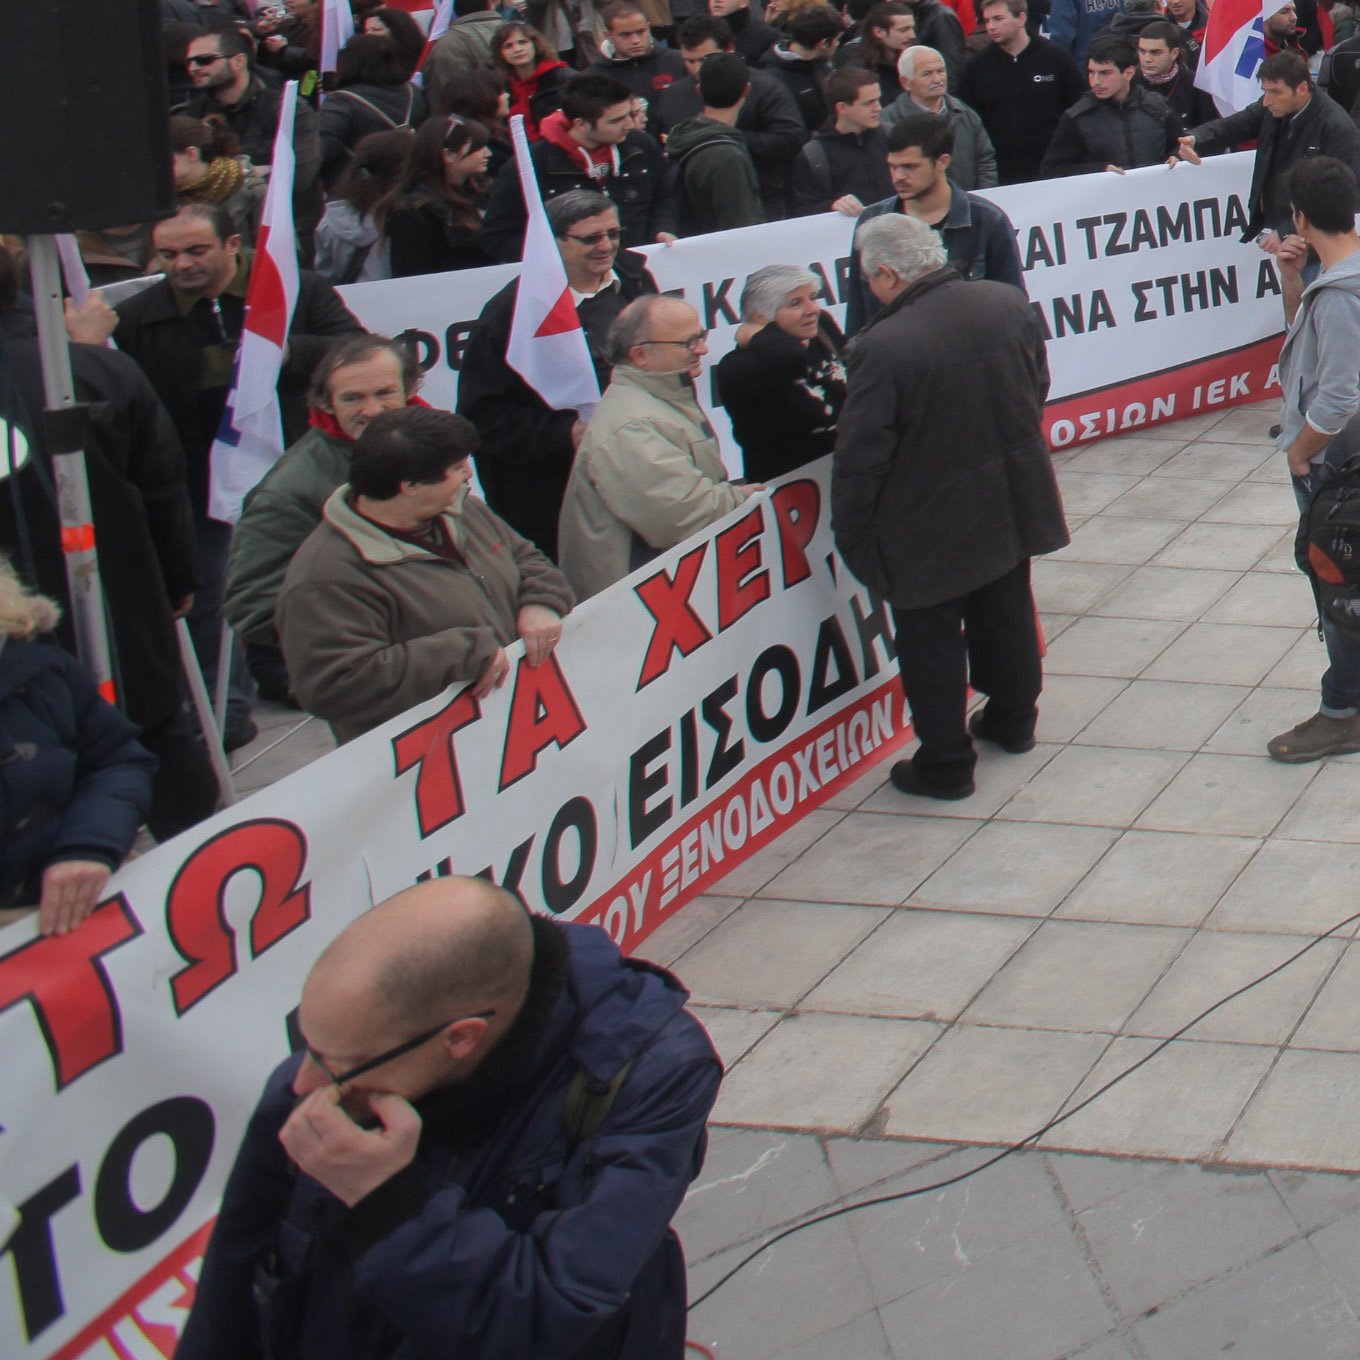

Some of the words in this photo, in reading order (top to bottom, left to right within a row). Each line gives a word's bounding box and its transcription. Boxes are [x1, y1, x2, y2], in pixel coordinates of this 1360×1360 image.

[1075, 193, 1250, 260] ΤΖΑΜΠΑ
[1132, 264, 1240, 323] ΣΤΗΝ
[1049, 392, 1177, 448] ΟΣΙΩΝ
[1192, 370, 1250, 410] ΙΕΚ
[391, 647, 588, 841] ΤΑ
[633, 477, 822, 695] ΧΕΡ
[629, 592, 899, 852] ΕΙΣΟΔΗ
[659, 706, 896, 903] ΞΕΝΟΔΟΧΕΙΩΝ
